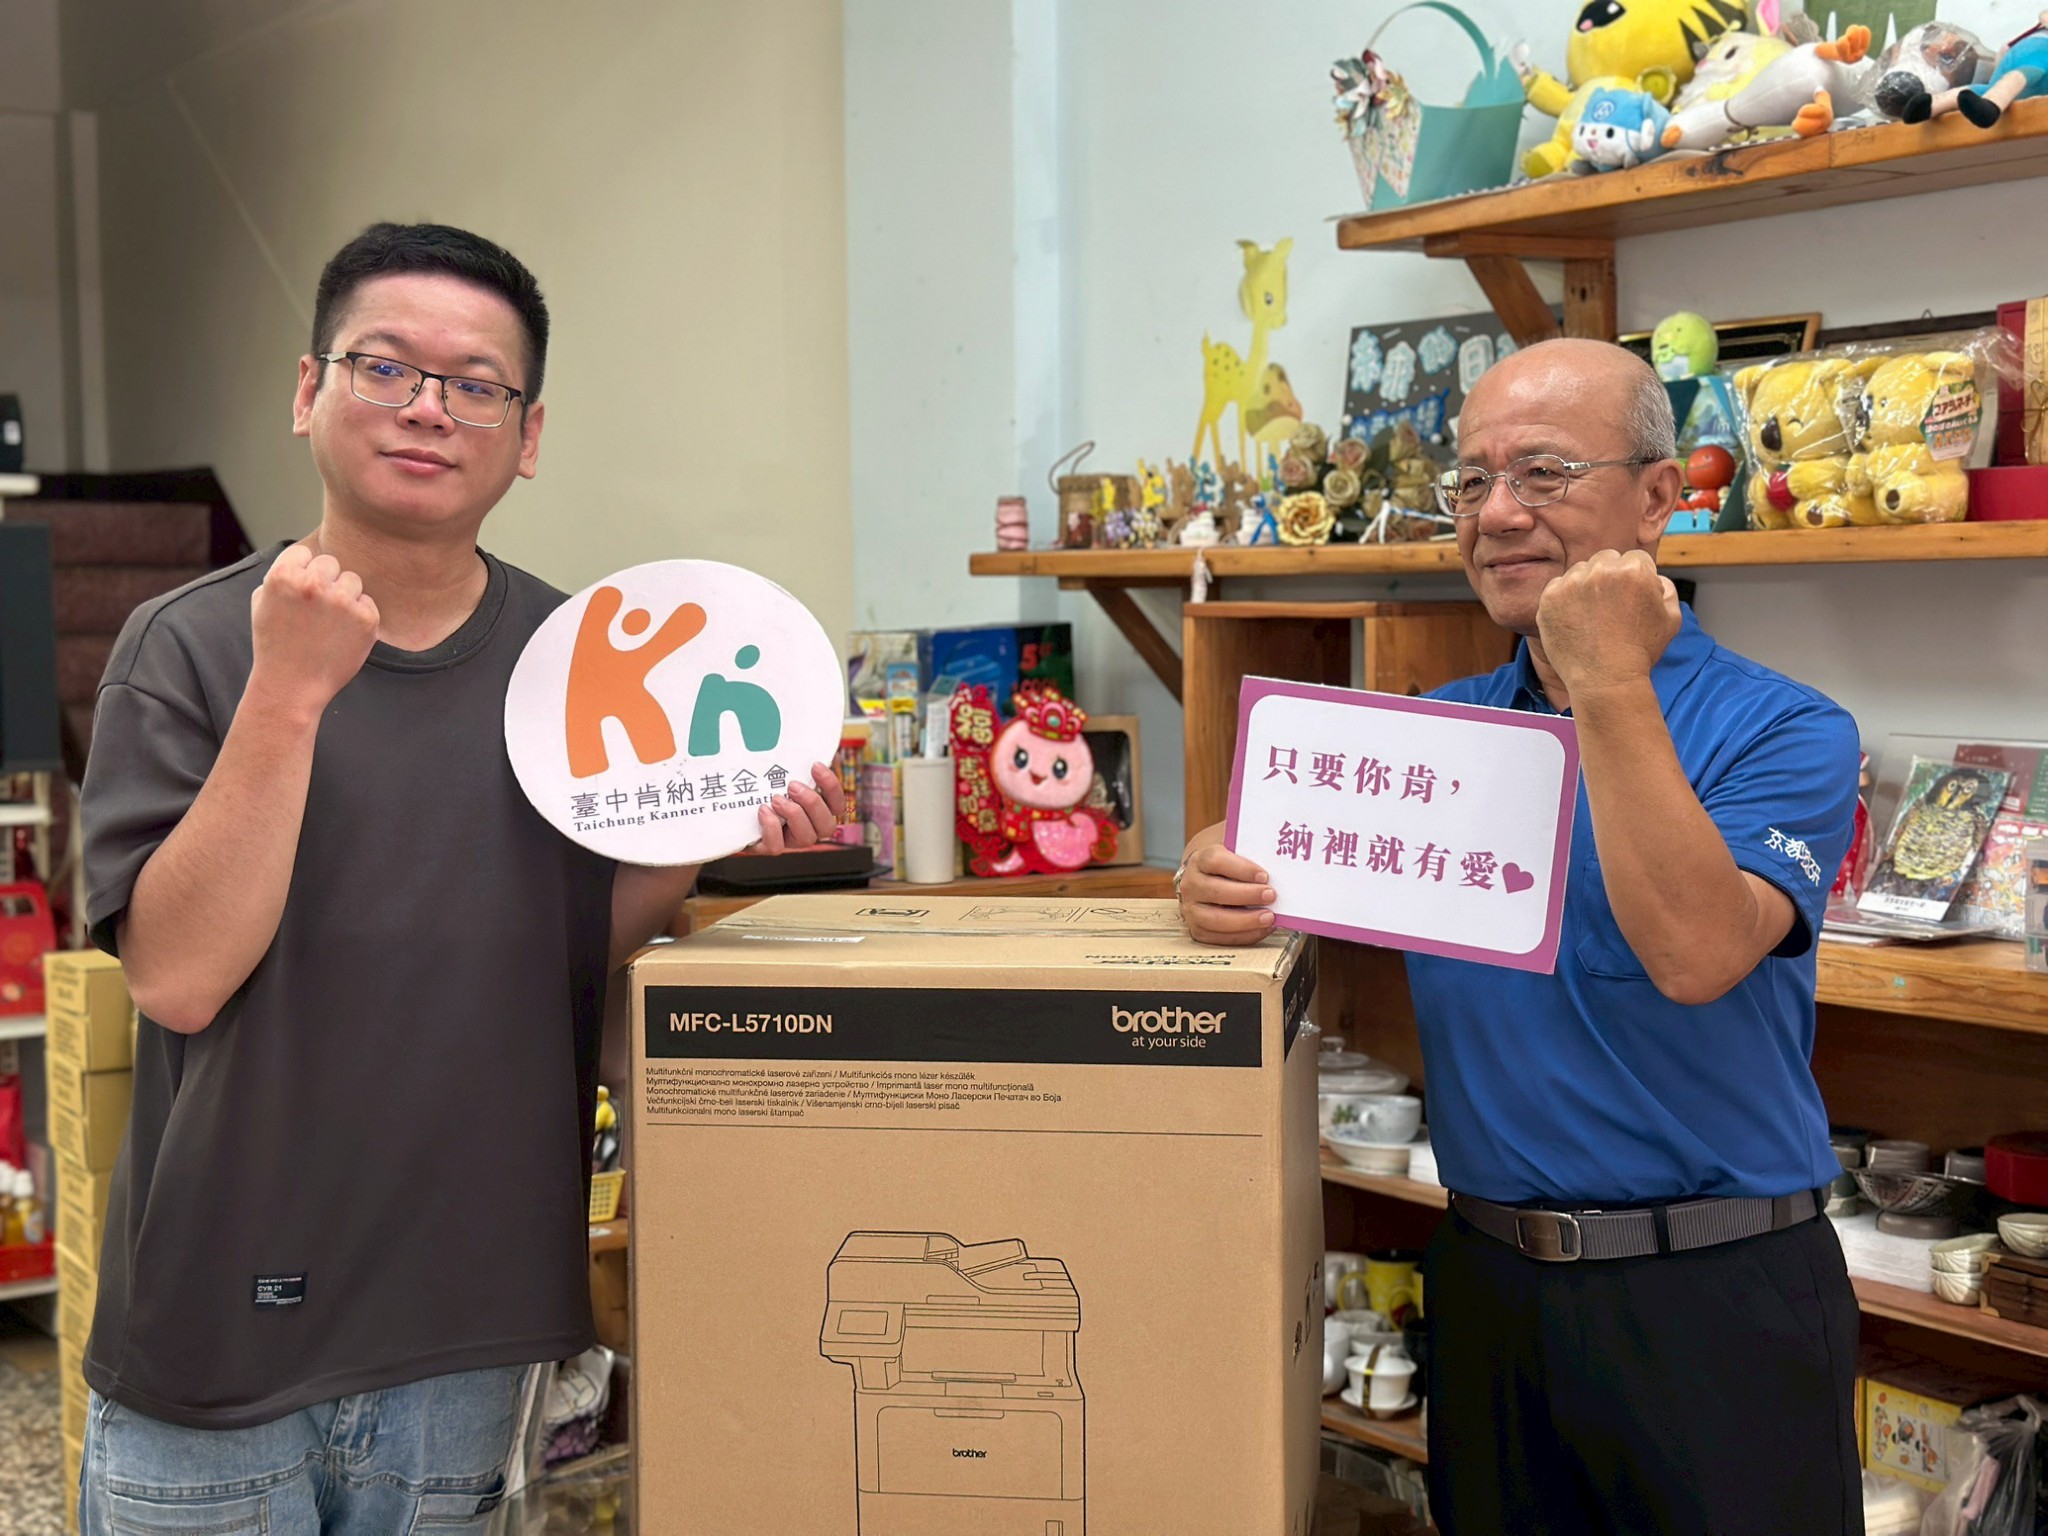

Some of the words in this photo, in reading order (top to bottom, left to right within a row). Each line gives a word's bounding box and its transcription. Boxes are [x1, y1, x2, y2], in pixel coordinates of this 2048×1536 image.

[1262, 745, 1460, 804] 只要你肯，
[571, 764, 790, 819] 臺中肯納基金會
[574, 815, 645, 832] Taichung
[650, 806, 705, 821] Kanner
[1276, 821, 1499, 890] 納裡就有愛
[670, 1012, 832, 1034] MFC-L5710DN
[1112, 1005, 1227, 1034] brother
[1131, 1036, 1145, 1047] at
[1148, 1038, 1177, 1050] your
[1180, 1035, 1206, 1047] side
[695, 1068, 765, 1077] monochromatické
[767, 1069, 800, 1078] laserové
[840, 1070, 892, 1079] Multifunkciós
[646, 1077, 730, 1087] Мултифункционално
[732, 1080, 784, 1088] монохромно
[786, 1081, 820, 1089] лазерно
[822, 1081, 869, 1090] устройство
[646, 1086, 716, 1095] Monochromatické
[770, 1089, 803, 1097] laserové
[805, 1090, 845, 1098] zariadenie
[926, 1091, 949, 1100] Моно
[951, 1092, 991, 1101] Ласерски
[994, 1092, 1029, 1101] Печатач
[1043, 1093, 1062, 1103] Боја
[735, 1097, 765, 1106] laserski
[767, 1098, 799, 1107] tiskalnik
[906, 1101, 936, 1109] laserski
[647, 1106, 712, 1115] Multifunkcionalni
[738, 1108, 768, 1116] laserski
[952, 1448, 987, 1458] brother
